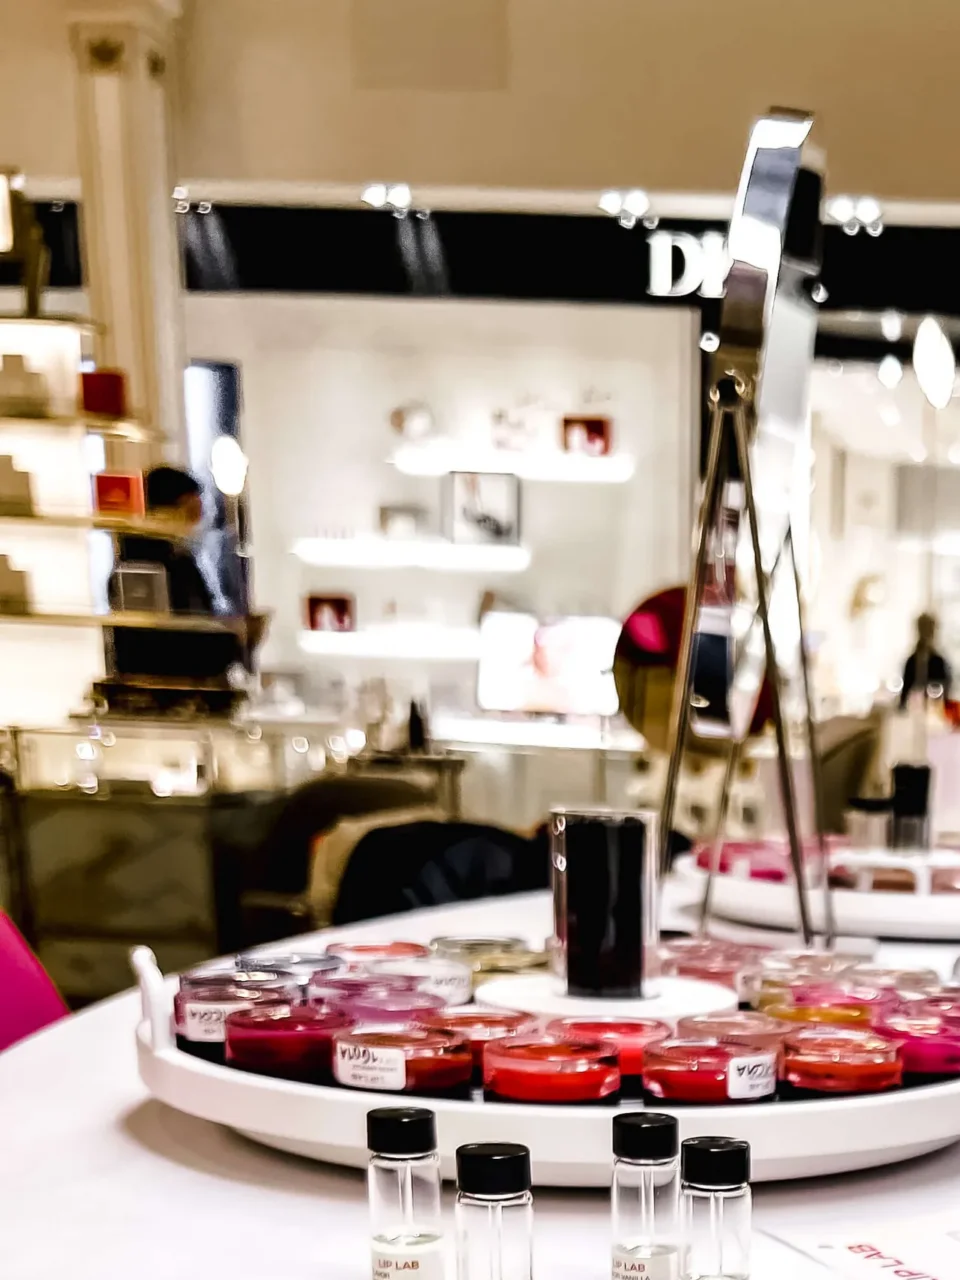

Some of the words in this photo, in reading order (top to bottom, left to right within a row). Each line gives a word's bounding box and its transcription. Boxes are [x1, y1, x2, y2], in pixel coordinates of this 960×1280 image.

[646, 229, 728, 298] DI
[378, 1259, 393, 1269] LIP
[395, 1260, 420, 1271] LAB
[847, 1244, 904, 1269] LAB
[624, 1262, 646, 1272] LAB
